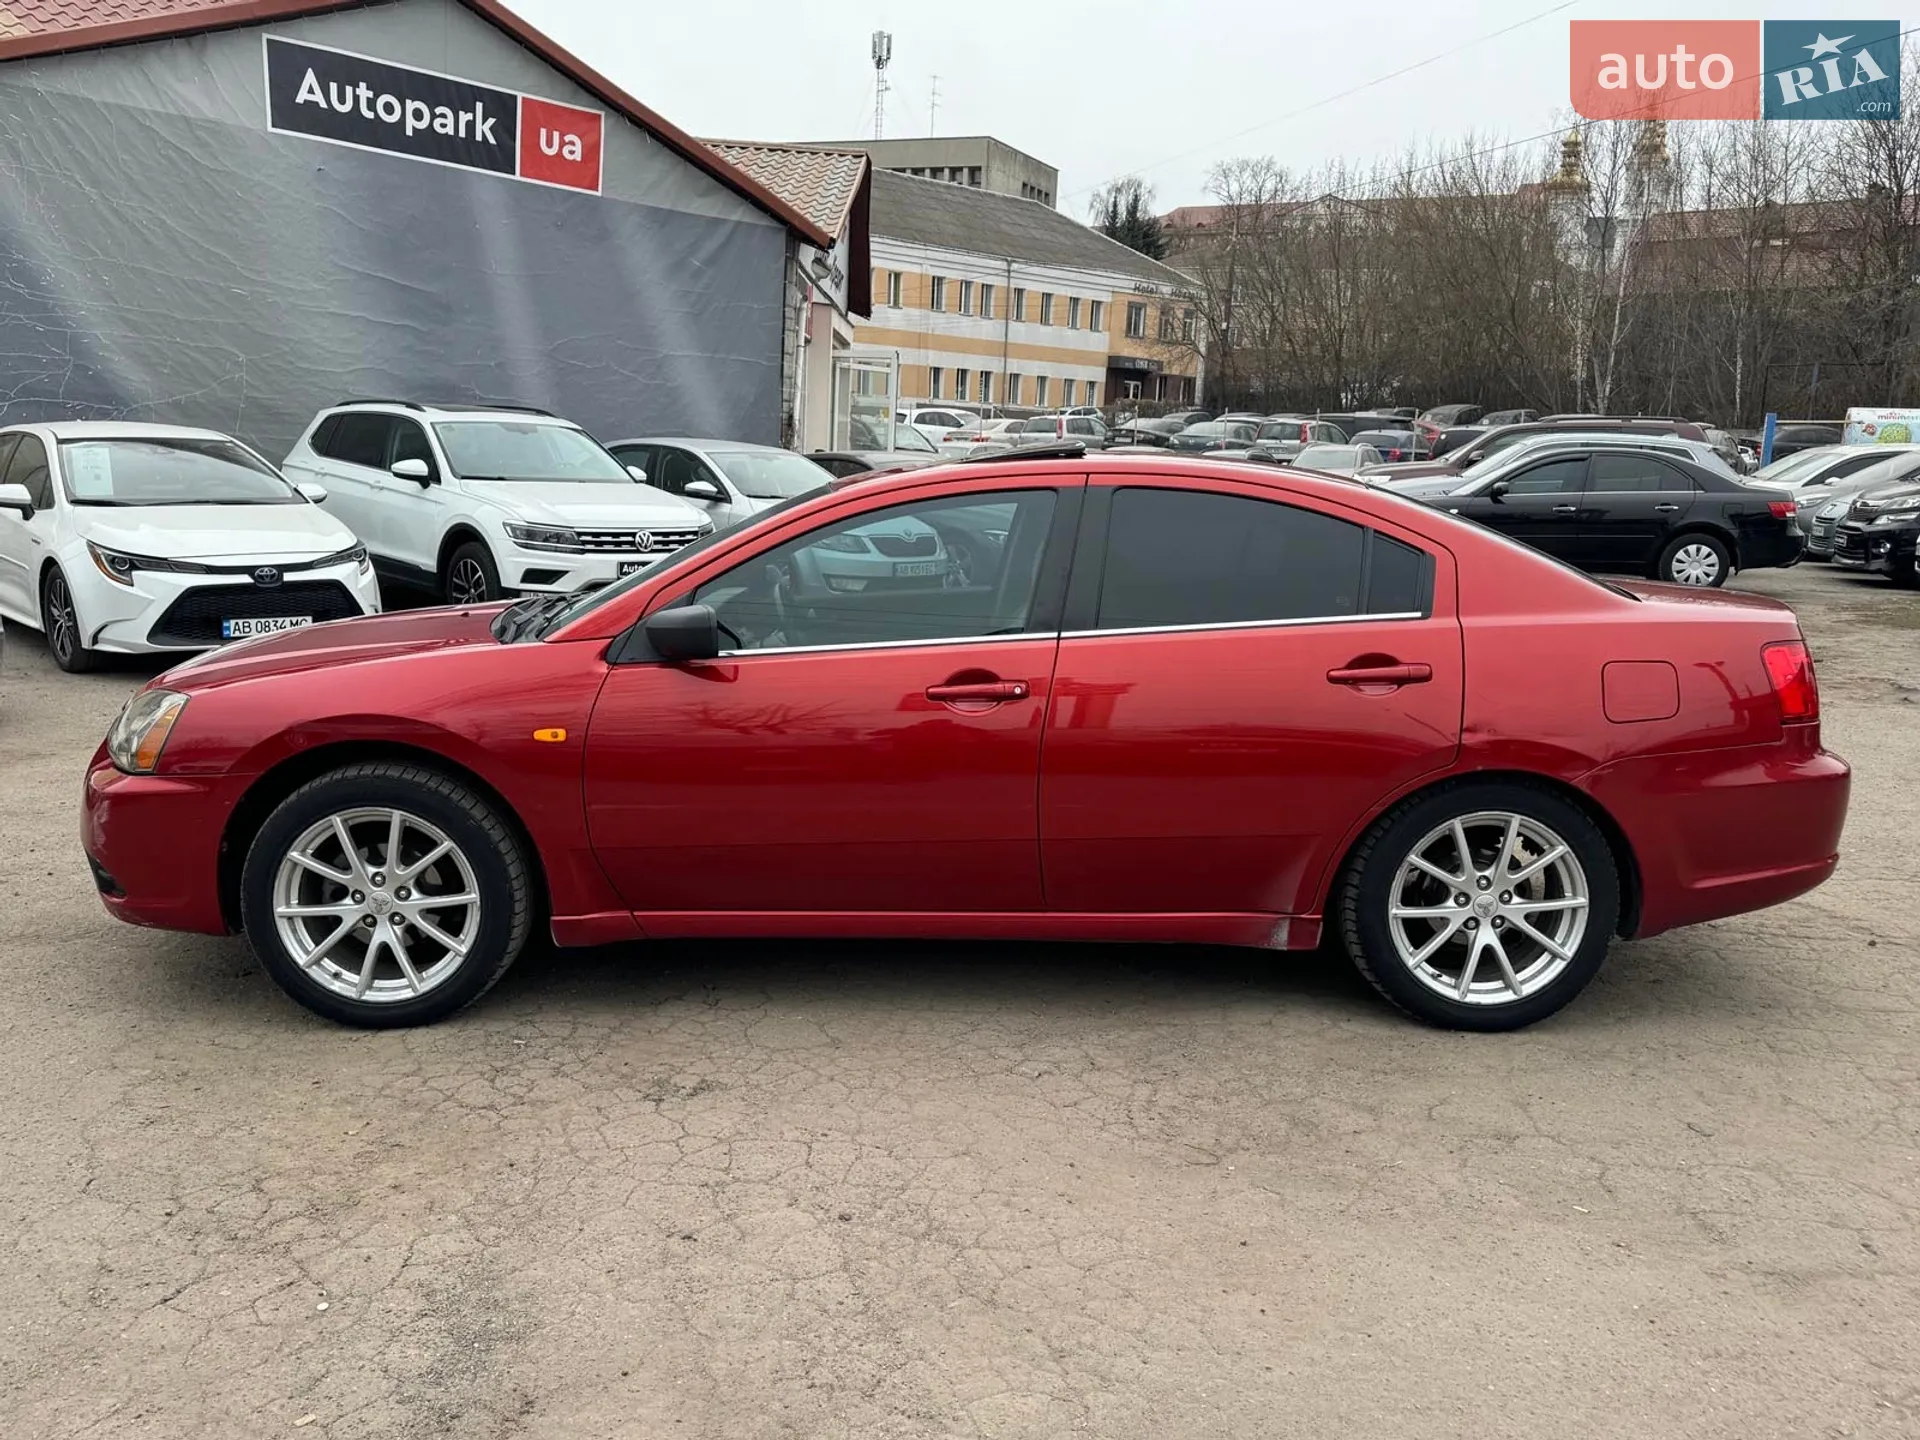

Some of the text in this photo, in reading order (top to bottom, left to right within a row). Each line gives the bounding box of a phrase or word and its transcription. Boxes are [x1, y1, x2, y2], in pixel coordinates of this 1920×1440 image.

[295, 67, 582, 162] Autopark ua
[232, 621, 252, 635] AB
[255, 619, 287, 634] 0834
